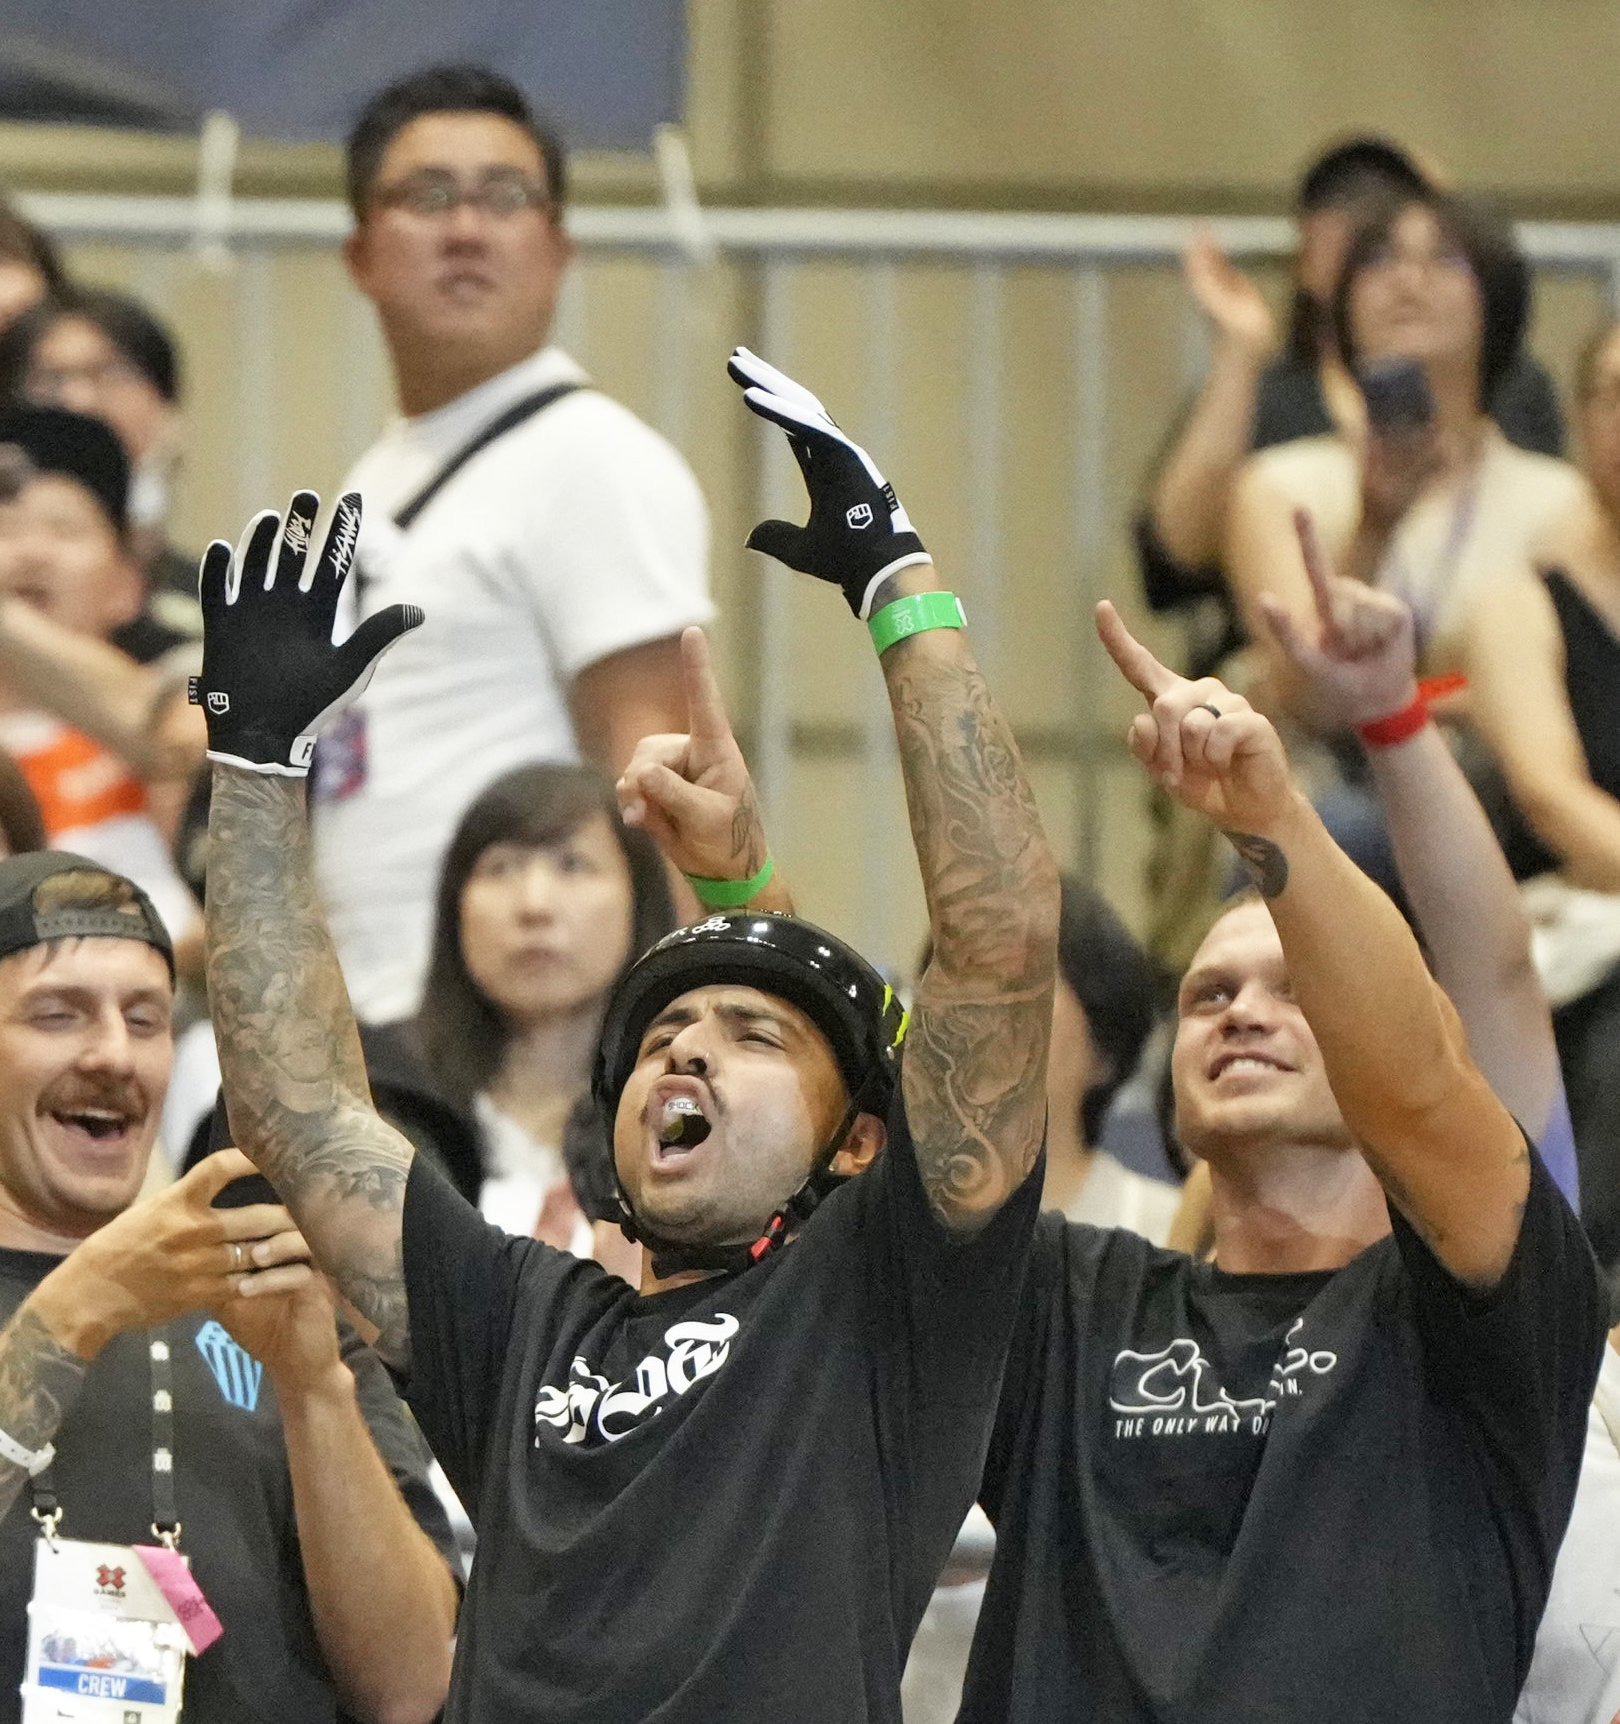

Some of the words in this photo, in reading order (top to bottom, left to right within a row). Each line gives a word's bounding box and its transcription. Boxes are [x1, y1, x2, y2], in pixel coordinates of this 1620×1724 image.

[1116, 1419, 1144, 1438] THE
[1153, 1417, 1197, 1436] ONLY
[1206, 1414, 1241, 1433] WAY
[78, 1673, 127, 1698] CREW
